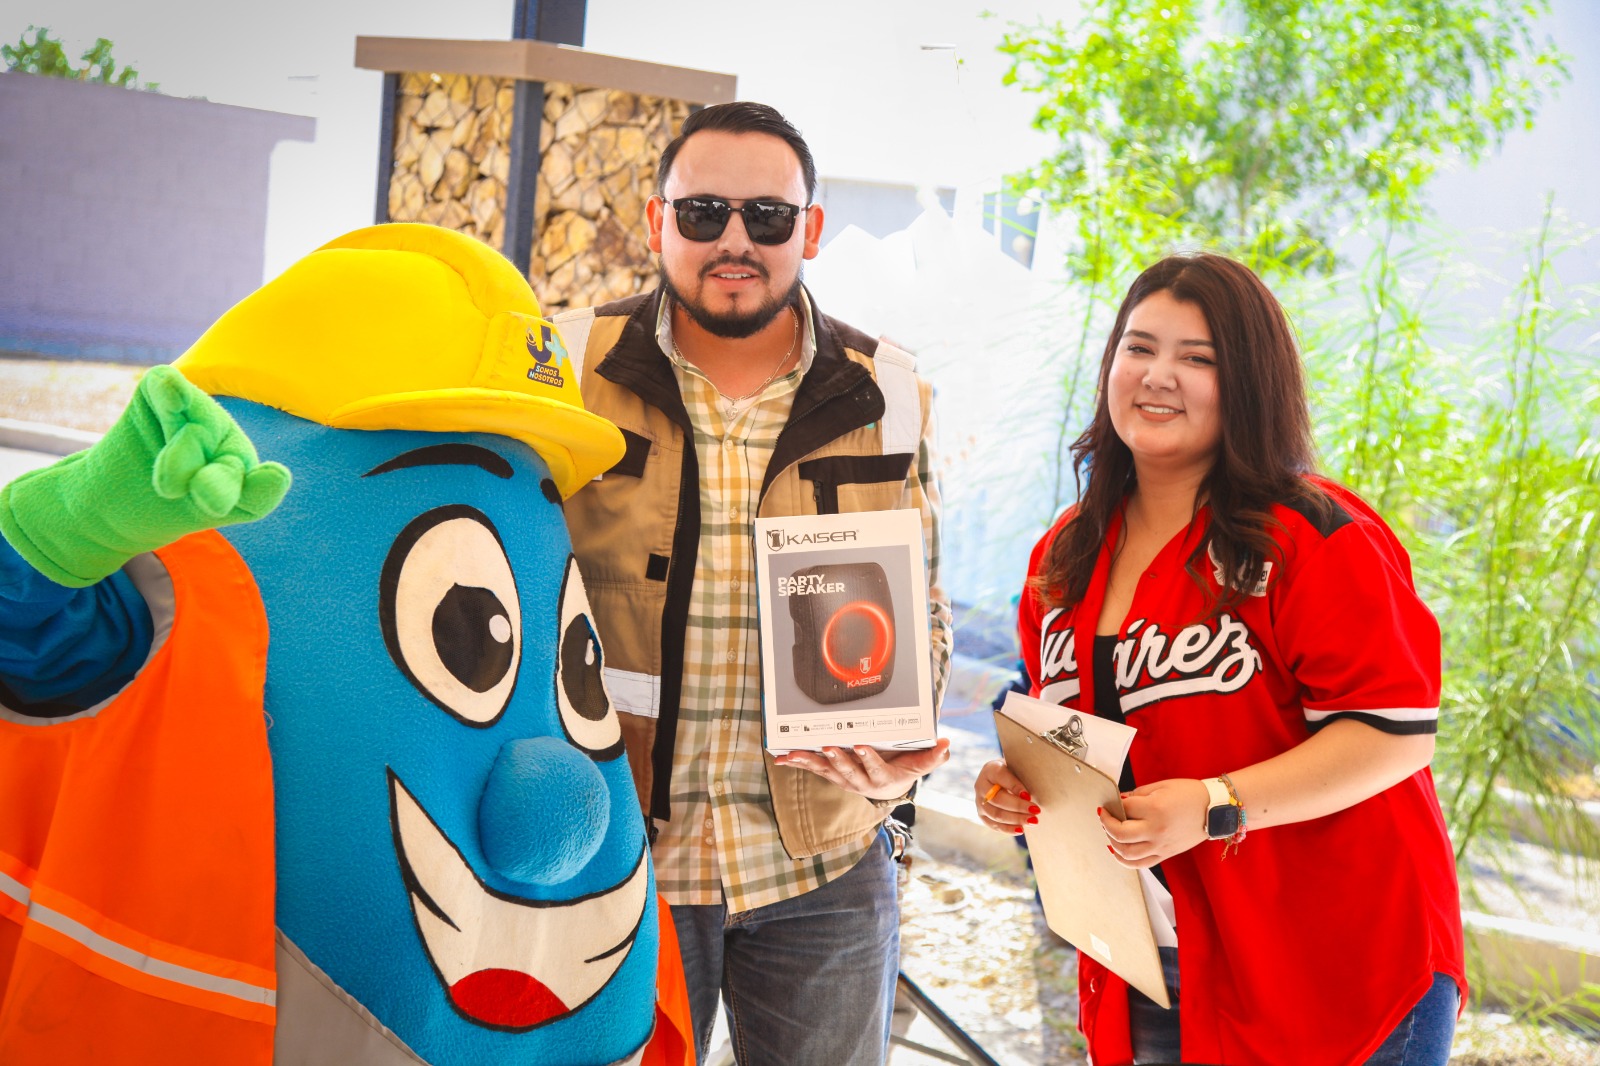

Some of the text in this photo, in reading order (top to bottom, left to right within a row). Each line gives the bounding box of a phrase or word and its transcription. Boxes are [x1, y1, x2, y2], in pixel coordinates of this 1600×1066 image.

[535, 365, 558, 377] SOMOS
[529, 371, 563, 386] NOSOTROS
[787, 530, 857, 545] KAISER
[777, 574, 825, 587] PARTY
[778, 583, 845, 597] SPEAKER
[847, 675, 881, 688] KAISER
